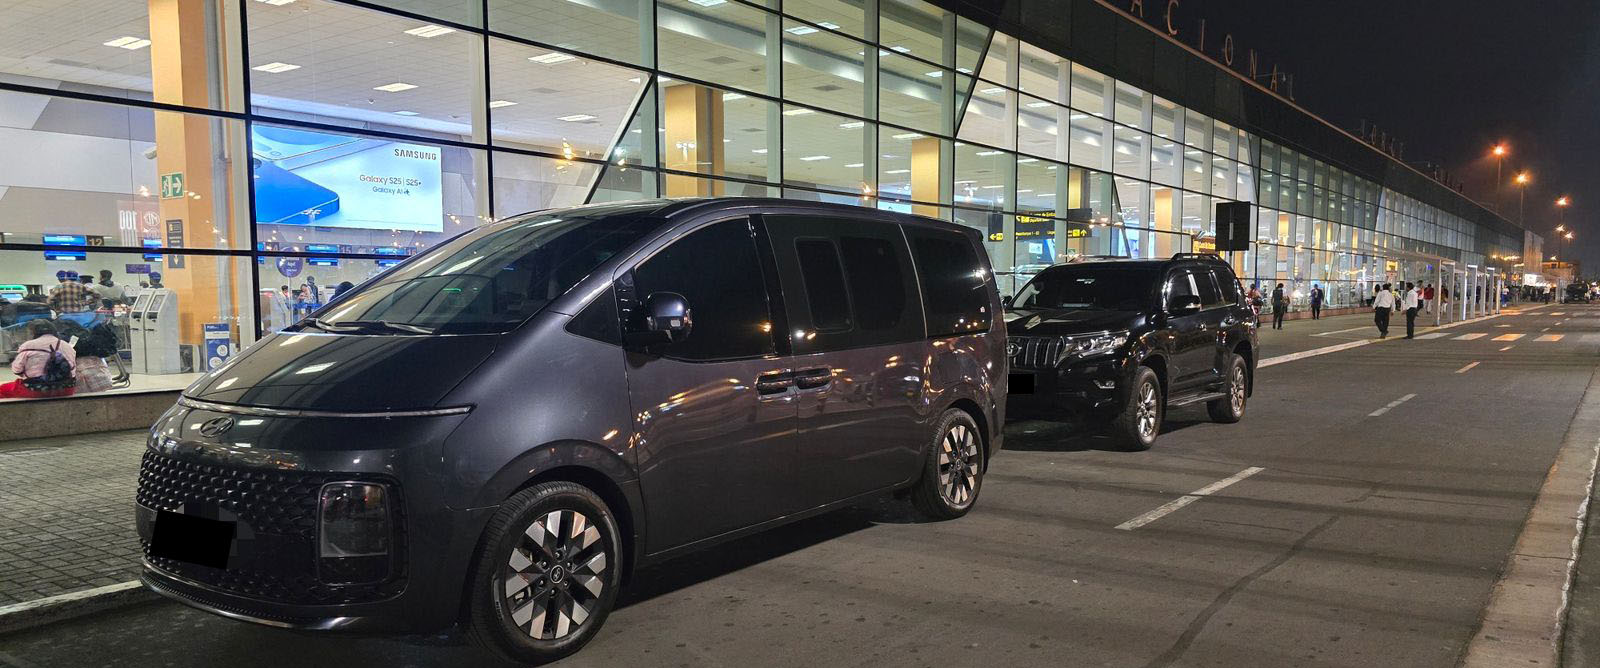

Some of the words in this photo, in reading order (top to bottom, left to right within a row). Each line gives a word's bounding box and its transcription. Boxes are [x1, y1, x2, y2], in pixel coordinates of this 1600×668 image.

[394, 148, 437, 161] SAMSUNG
[360, 174, 388, 185] Galaxy
[389, 176, 402, 185] S25
[372, 186, 396, 195] Galaxy
